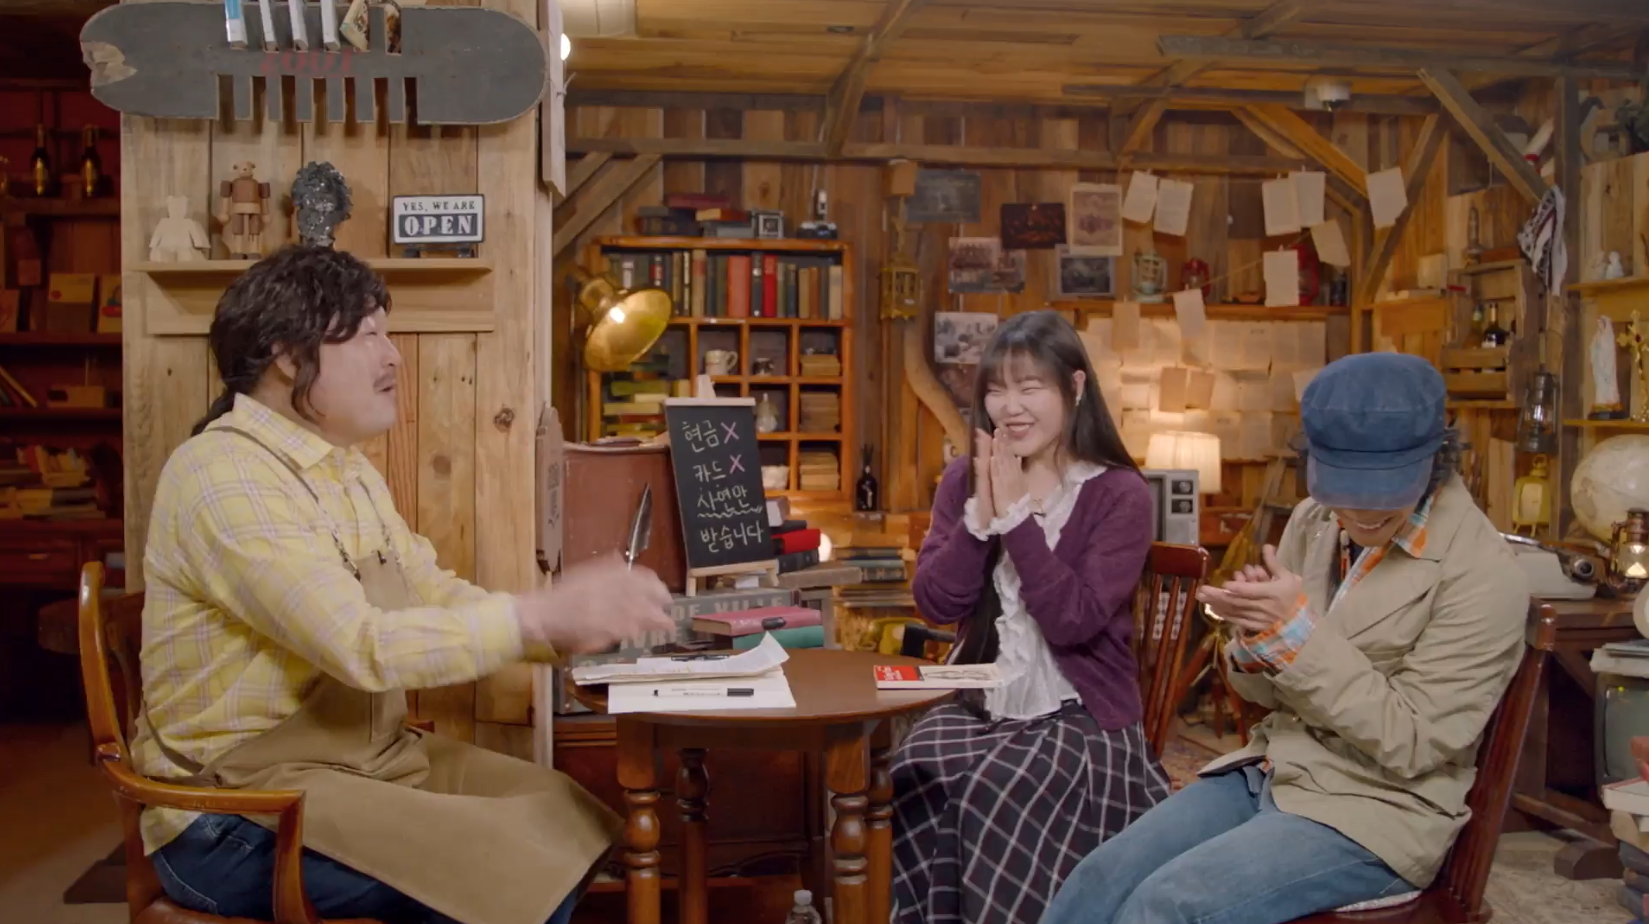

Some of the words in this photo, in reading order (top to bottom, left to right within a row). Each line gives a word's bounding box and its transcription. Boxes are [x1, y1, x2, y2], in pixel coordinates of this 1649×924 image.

[403, 202, 428, 212] YES,
[432, 201, 449, 210] WE
[453, 201, 475, 210] ARE
[404, 215, 472, 236] OPEN
[681, 420, 719, 453] 현금
[693, 461, 727, 482] 카드
[697, 485, 750, 511] 사연만
[700, 520, 764, 552] 받습니다
